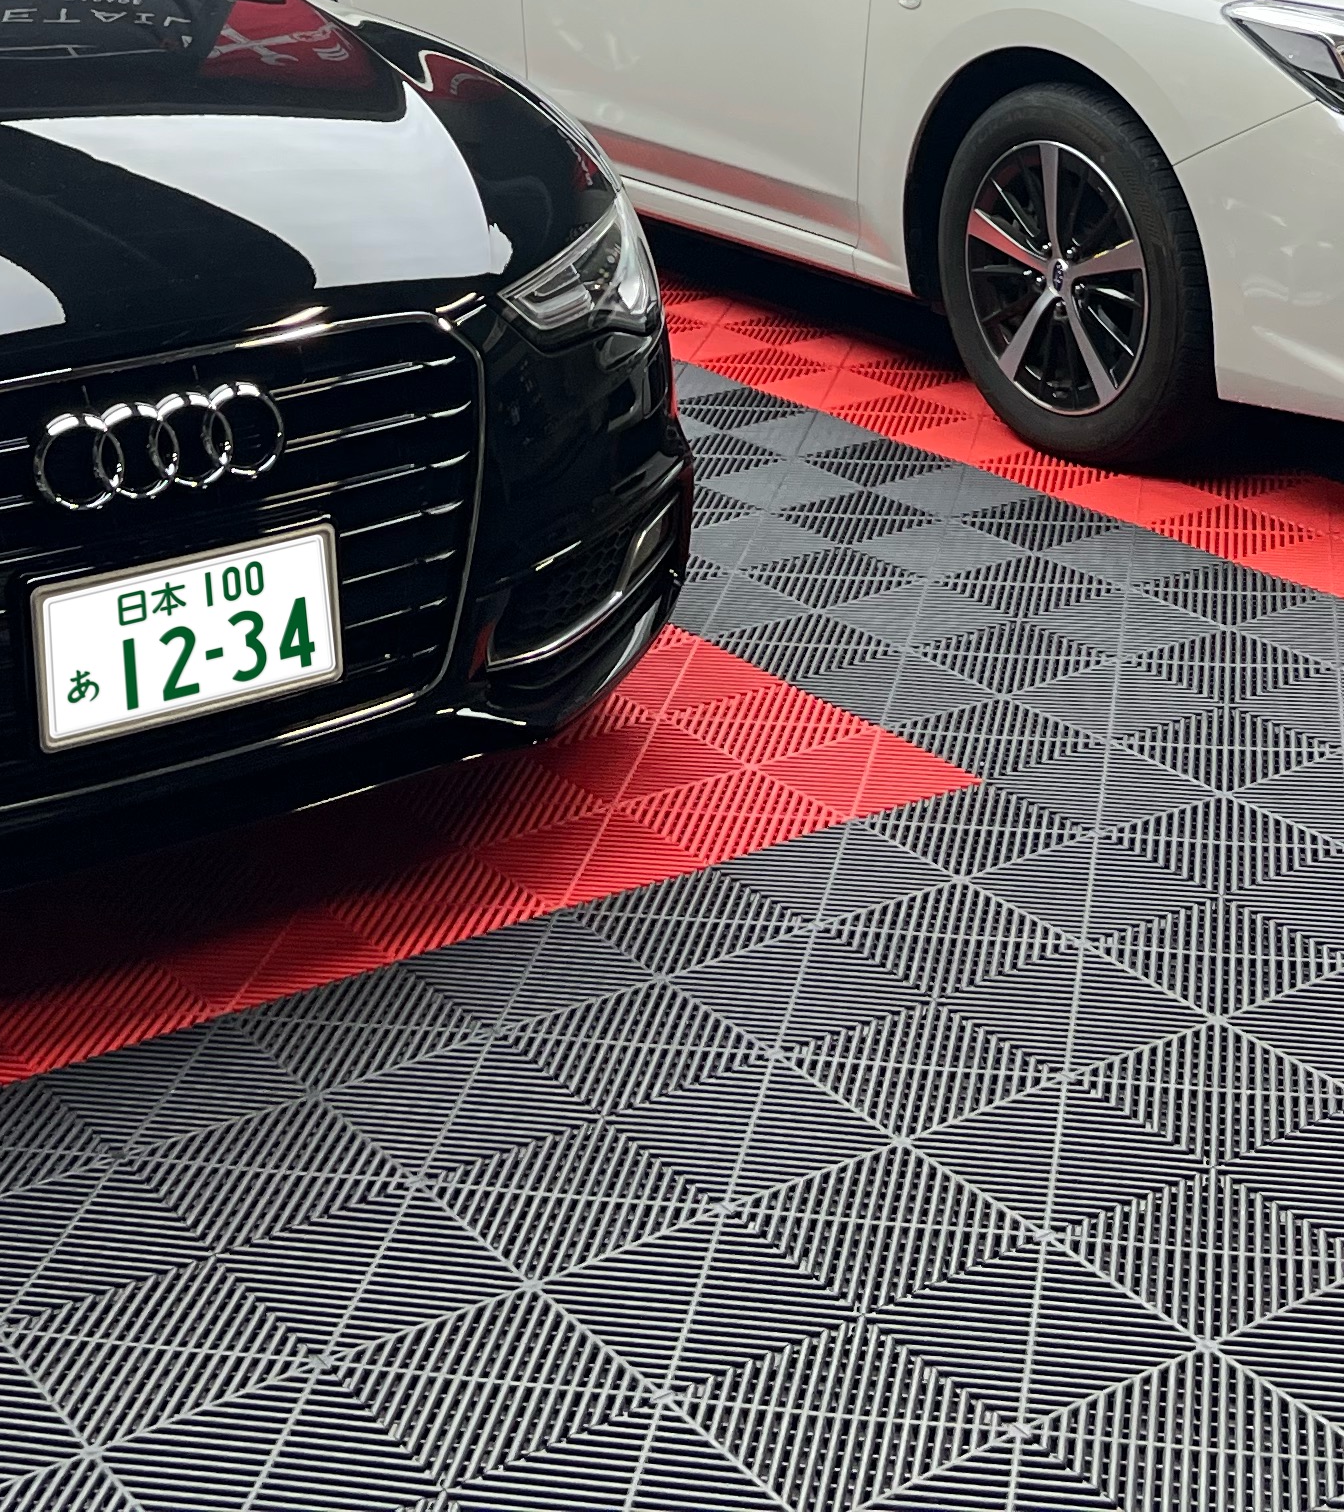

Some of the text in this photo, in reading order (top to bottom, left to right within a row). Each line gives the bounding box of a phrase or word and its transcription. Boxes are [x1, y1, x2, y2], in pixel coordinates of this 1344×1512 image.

[117, 561, 265, 626] 日本 100
[66, 597, 316, 711] あ 12-34
